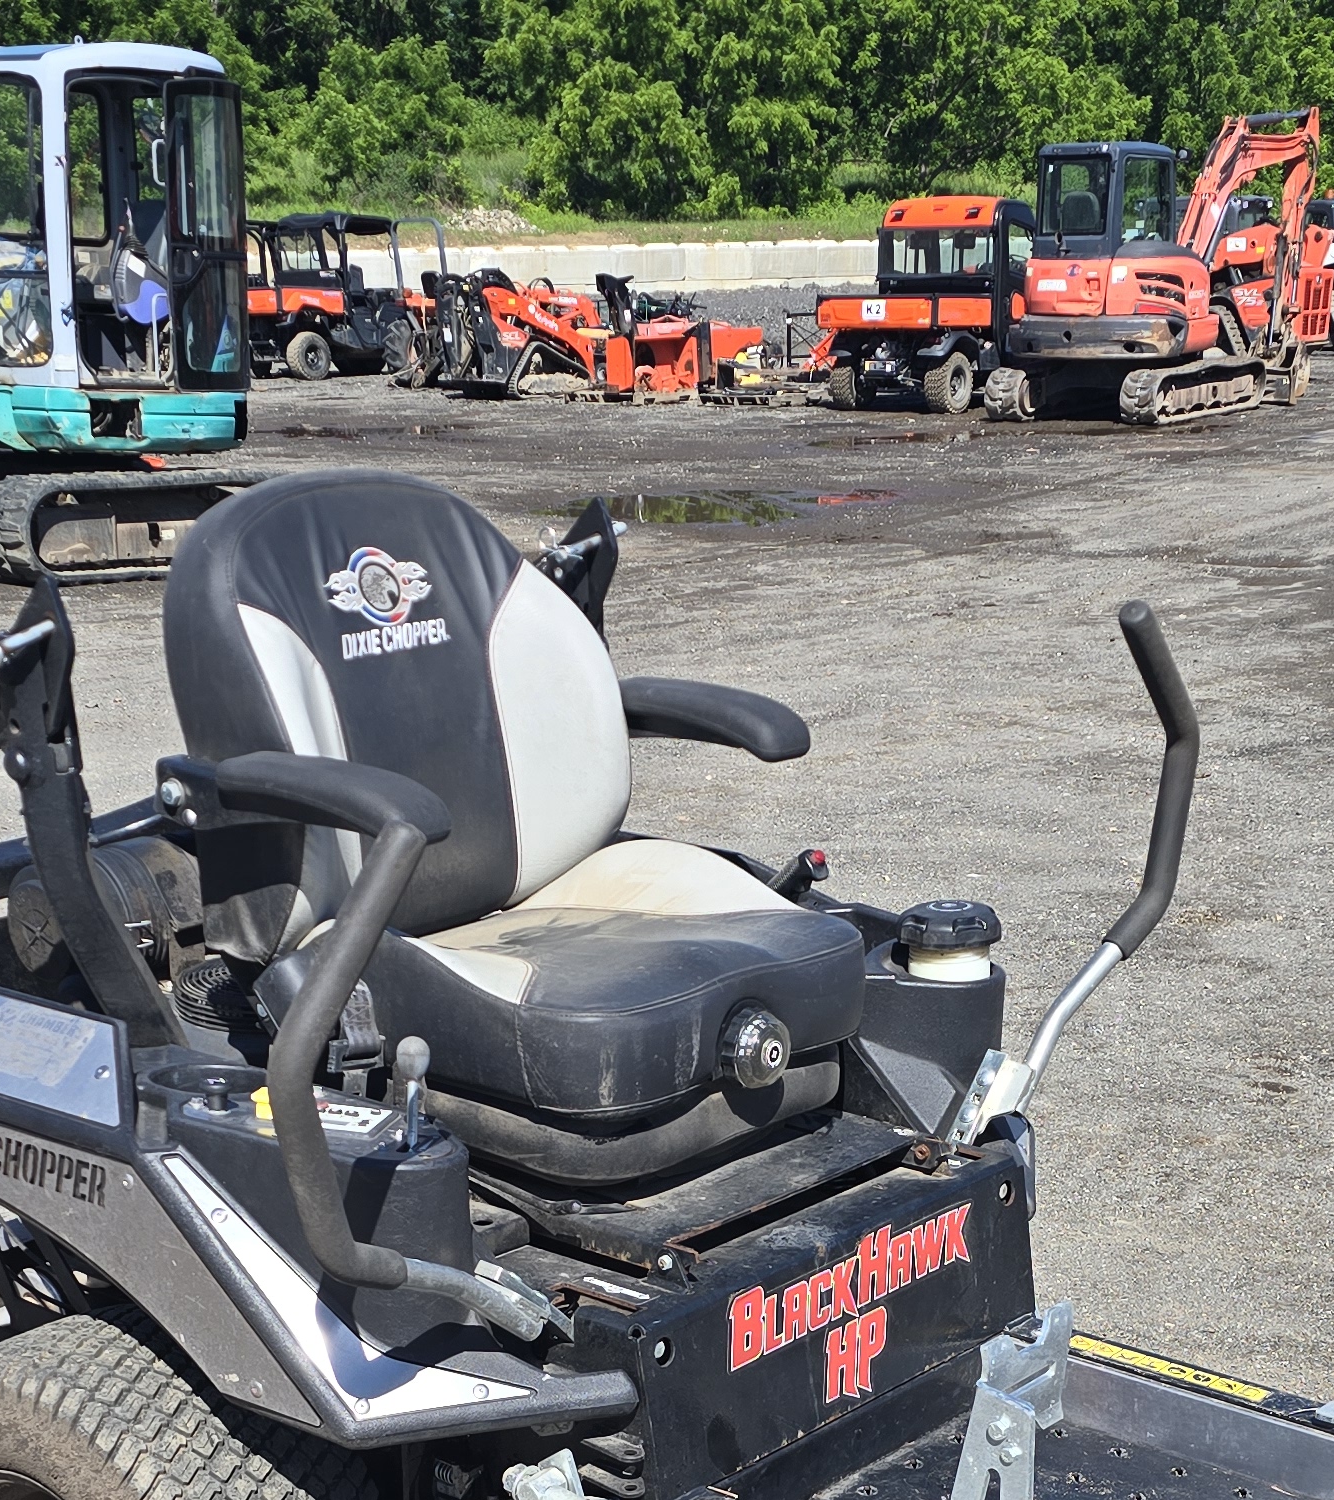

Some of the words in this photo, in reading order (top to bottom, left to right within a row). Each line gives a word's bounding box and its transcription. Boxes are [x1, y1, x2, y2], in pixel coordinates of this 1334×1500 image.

[341, 629, 383, 661] DIXIE
[381, 618, 451, 653] CHOPPER
[825, 1305, 887, 1403] HP
